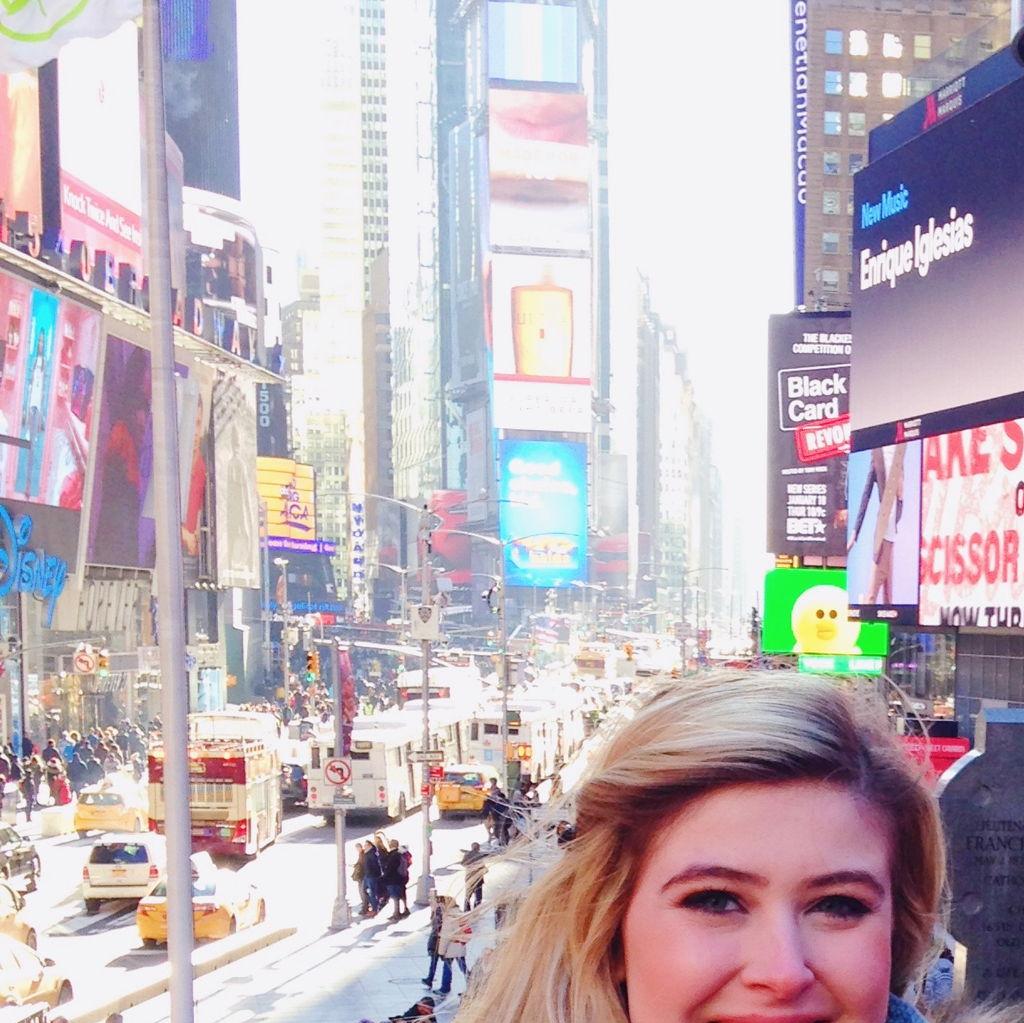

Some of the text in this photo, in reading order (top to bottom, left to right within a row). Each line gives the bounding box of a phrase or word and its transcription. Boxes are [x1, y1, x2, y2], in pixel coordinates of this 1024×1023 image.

[861, 184, 909, 229] New Music
[861, 207, 974, 291] Enrique Iglesias
[787, 373, 848, 398] Black
[788, 397, 839, 422] Card
